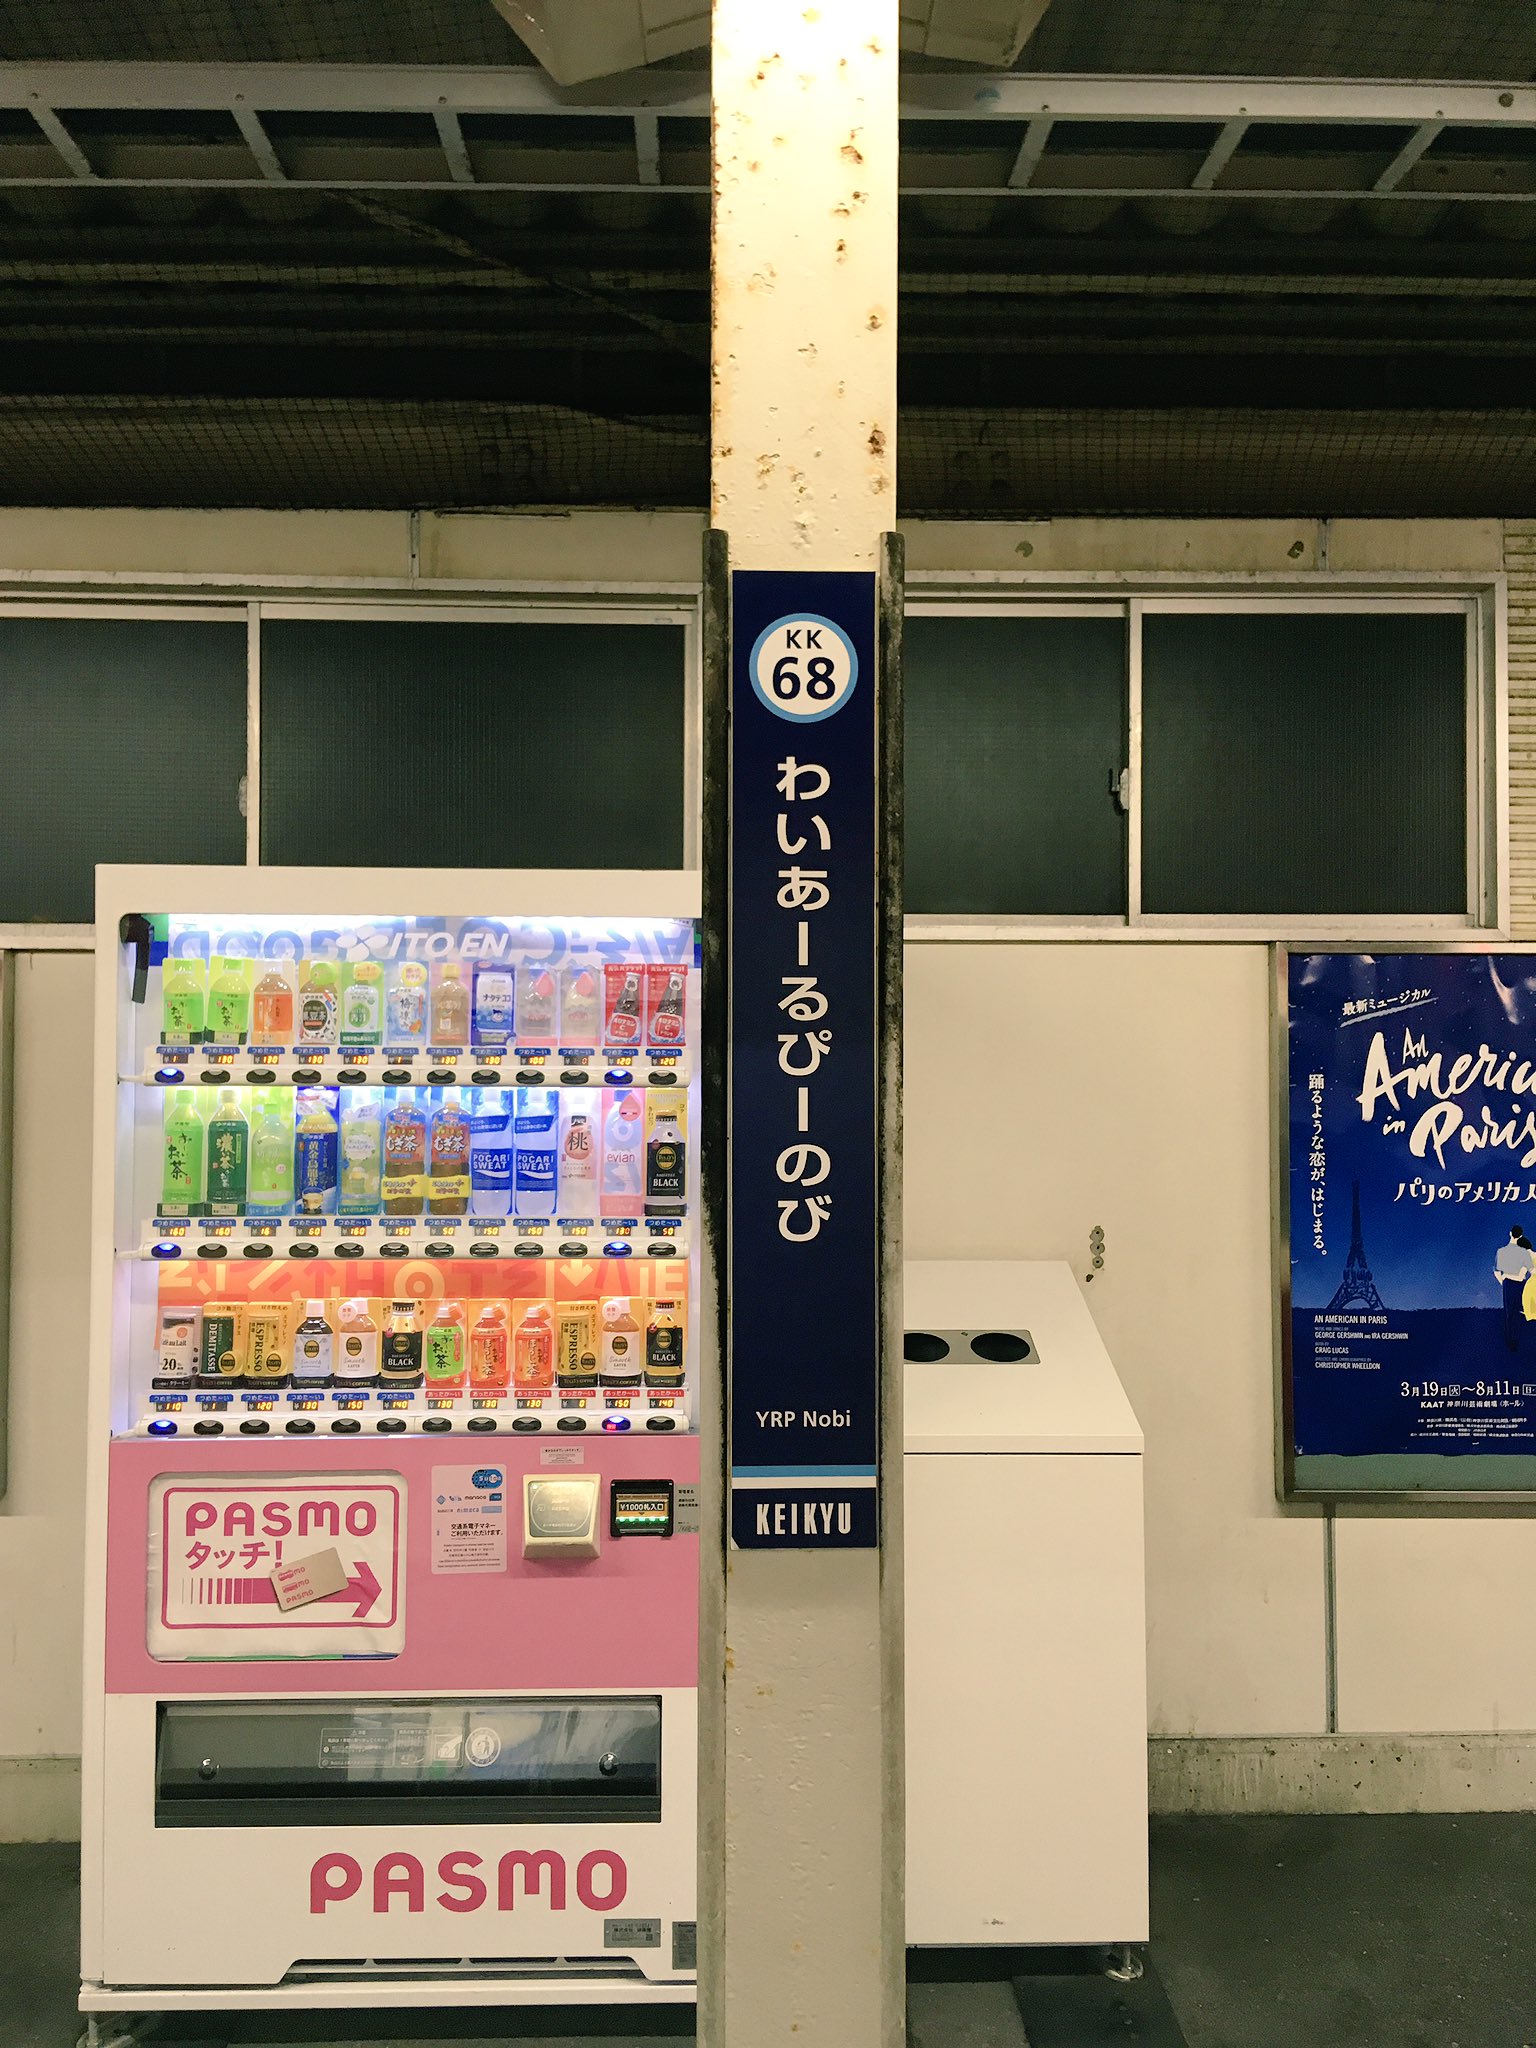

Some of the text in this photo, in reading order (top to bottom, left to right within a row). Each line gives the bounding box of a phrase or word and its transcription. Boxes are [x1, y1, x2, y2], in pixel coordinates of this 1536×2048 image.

[787, 629, 822, 649] KK
[773, 656, 835, 700] 68
[387, 932, 508, 959] ITO EN
[482, 993, 512, 1002] ナタデココ
[776, 756, 832, 1242] わいあーるぴーのび
[1342, 989, 1431, 1015] 最新ミュージカル
[1403, 1027, 1428, 1064] An
[1356, 1032, 1536, 1121] Americ
[1383, 1116, 1406, 1135] in
[568, 1131, 588, 1151] 桃
[473, 1154, 510, 1162] POCARI
[518, 1155, 554, 1163] POCARI
[607, 1153, 635, 1163] evian
[653, 1179, 679, 1187] BLACK
[1325, 1315, 1358, 1323] AMERICAN
[1368, 1316, 1387, 1324] PARIS
[208, 1323, 217, 1372] DEMITASSE
[254, 1322, 264, 1371] ESPRESSO
[569, 1322, 578, 1371] ESPRESSO
[162, 1358, 176, 1370] 20
[388, 1358, 414, 1366] BLACK
[652, 1353, 676, 1362] BLACK
[756, 1409, 850, 1427] YRP Nobi
[186, 1501, 377, 1537] PASMO
[757, 1503, 851, 1535] KEIKYU
[286, 1590, 314, 1603] PASMO
[310, 1850, 627, 1913] PASMO
